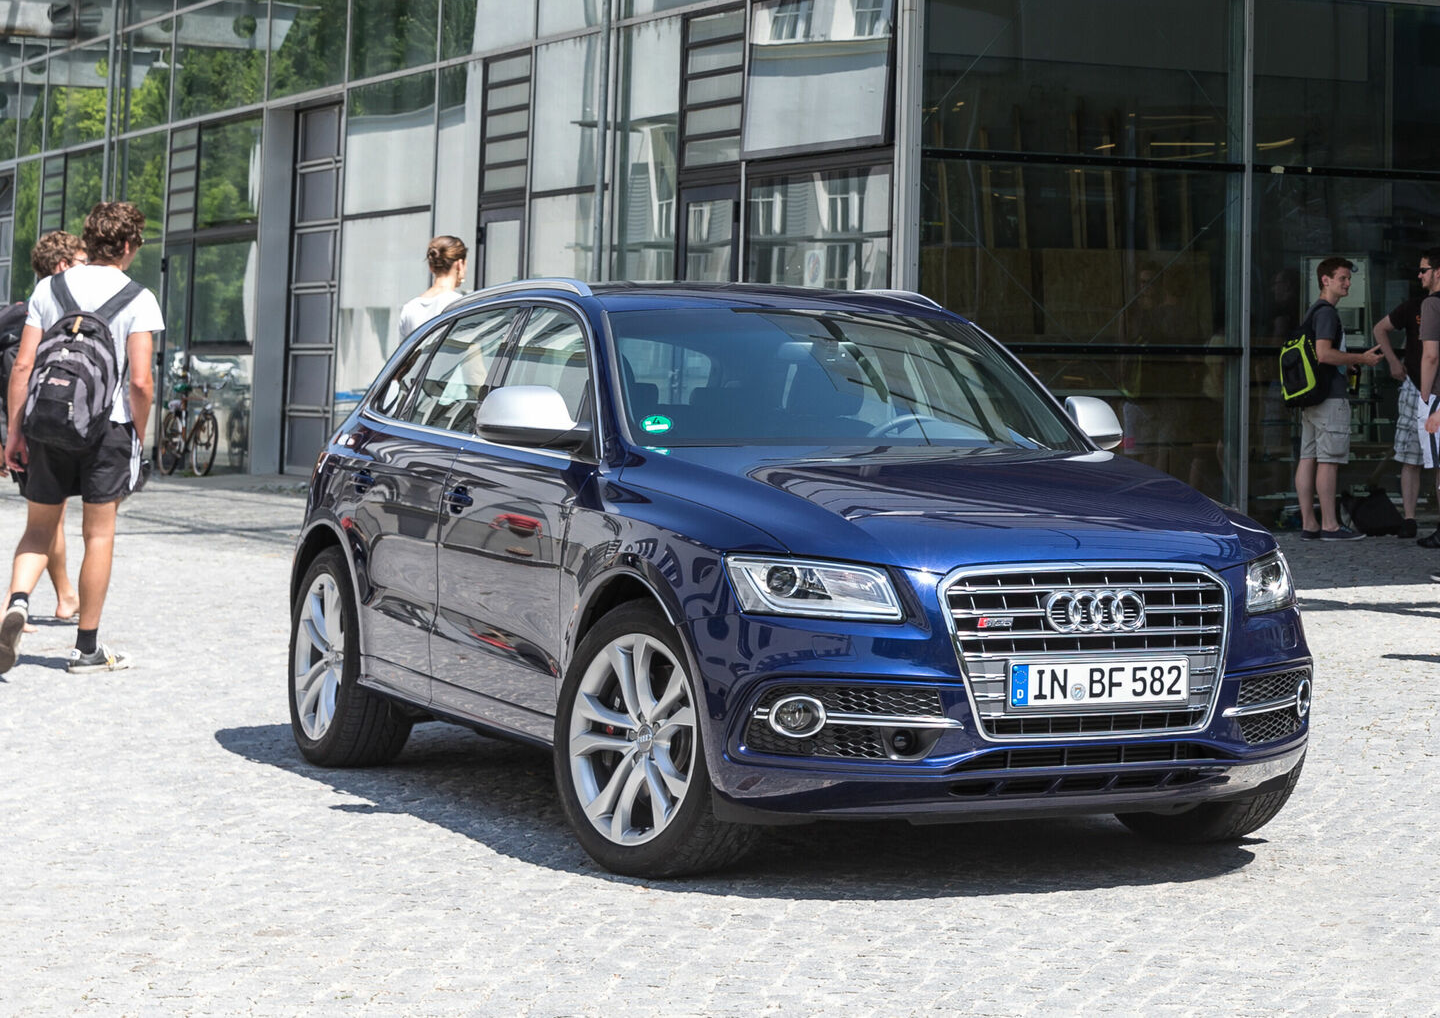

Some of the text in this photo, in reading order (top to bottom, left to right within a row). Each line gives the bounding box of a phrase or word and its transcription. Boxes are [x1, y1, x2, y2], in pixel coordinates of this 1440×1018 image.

[1034, 665, 1182, 700] IN BF 582
[1016, 689, 1024, 699] D
